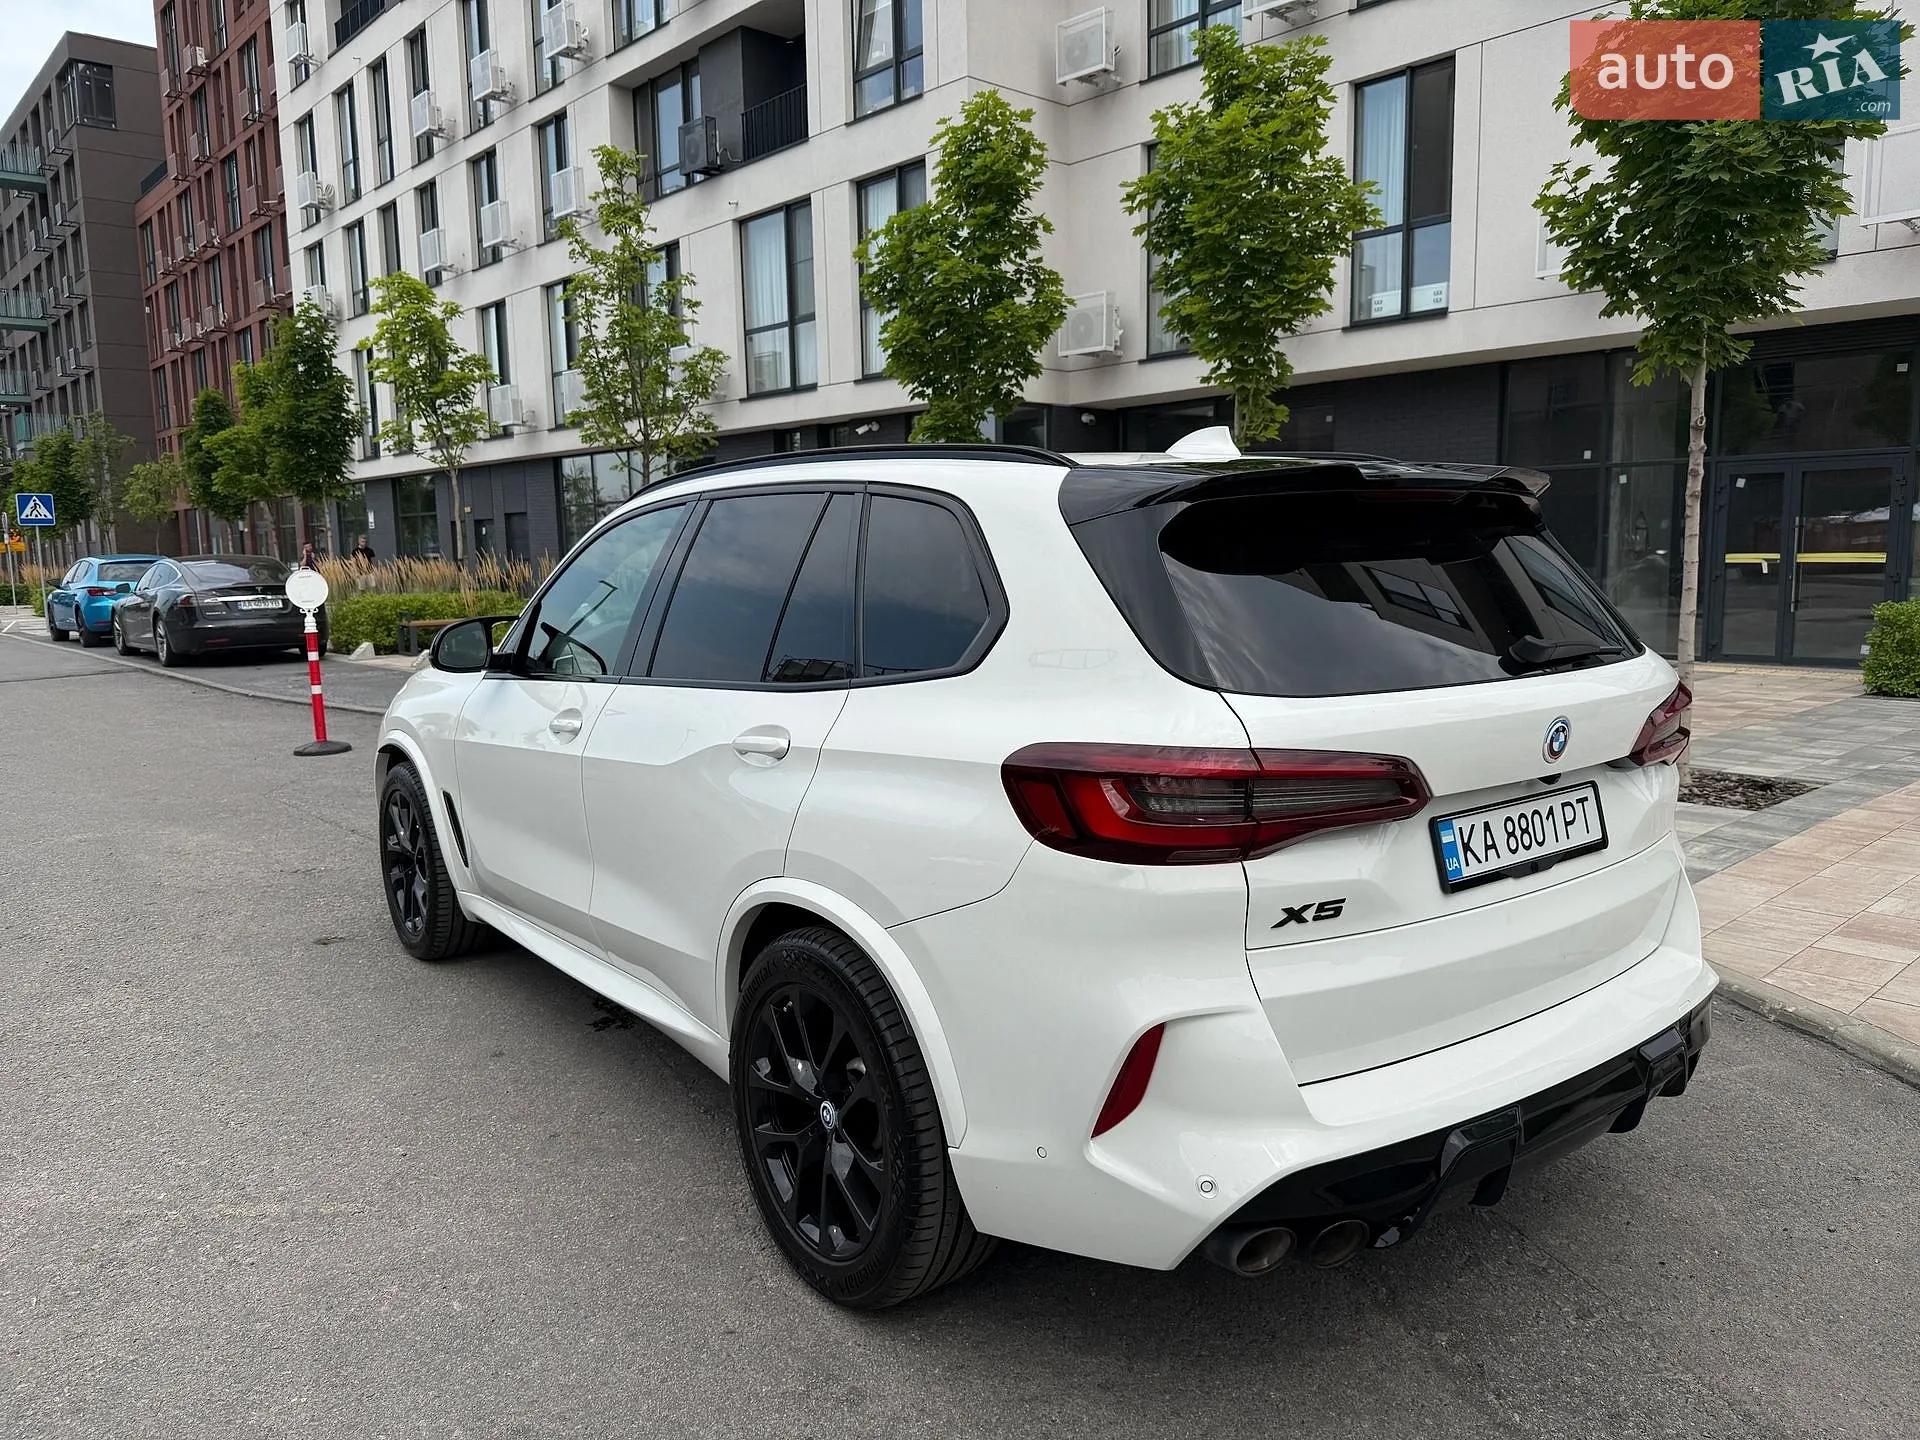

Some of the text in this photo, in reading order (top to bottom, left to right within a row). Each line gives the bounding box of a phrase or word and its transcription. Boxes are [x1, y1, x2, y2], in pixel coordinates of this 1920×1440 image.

[1459, 796, 1589, 866] KA 8801 PT
[1446, 857, 1459, 870] UA
[1271, 898, 1346, 929] X5
